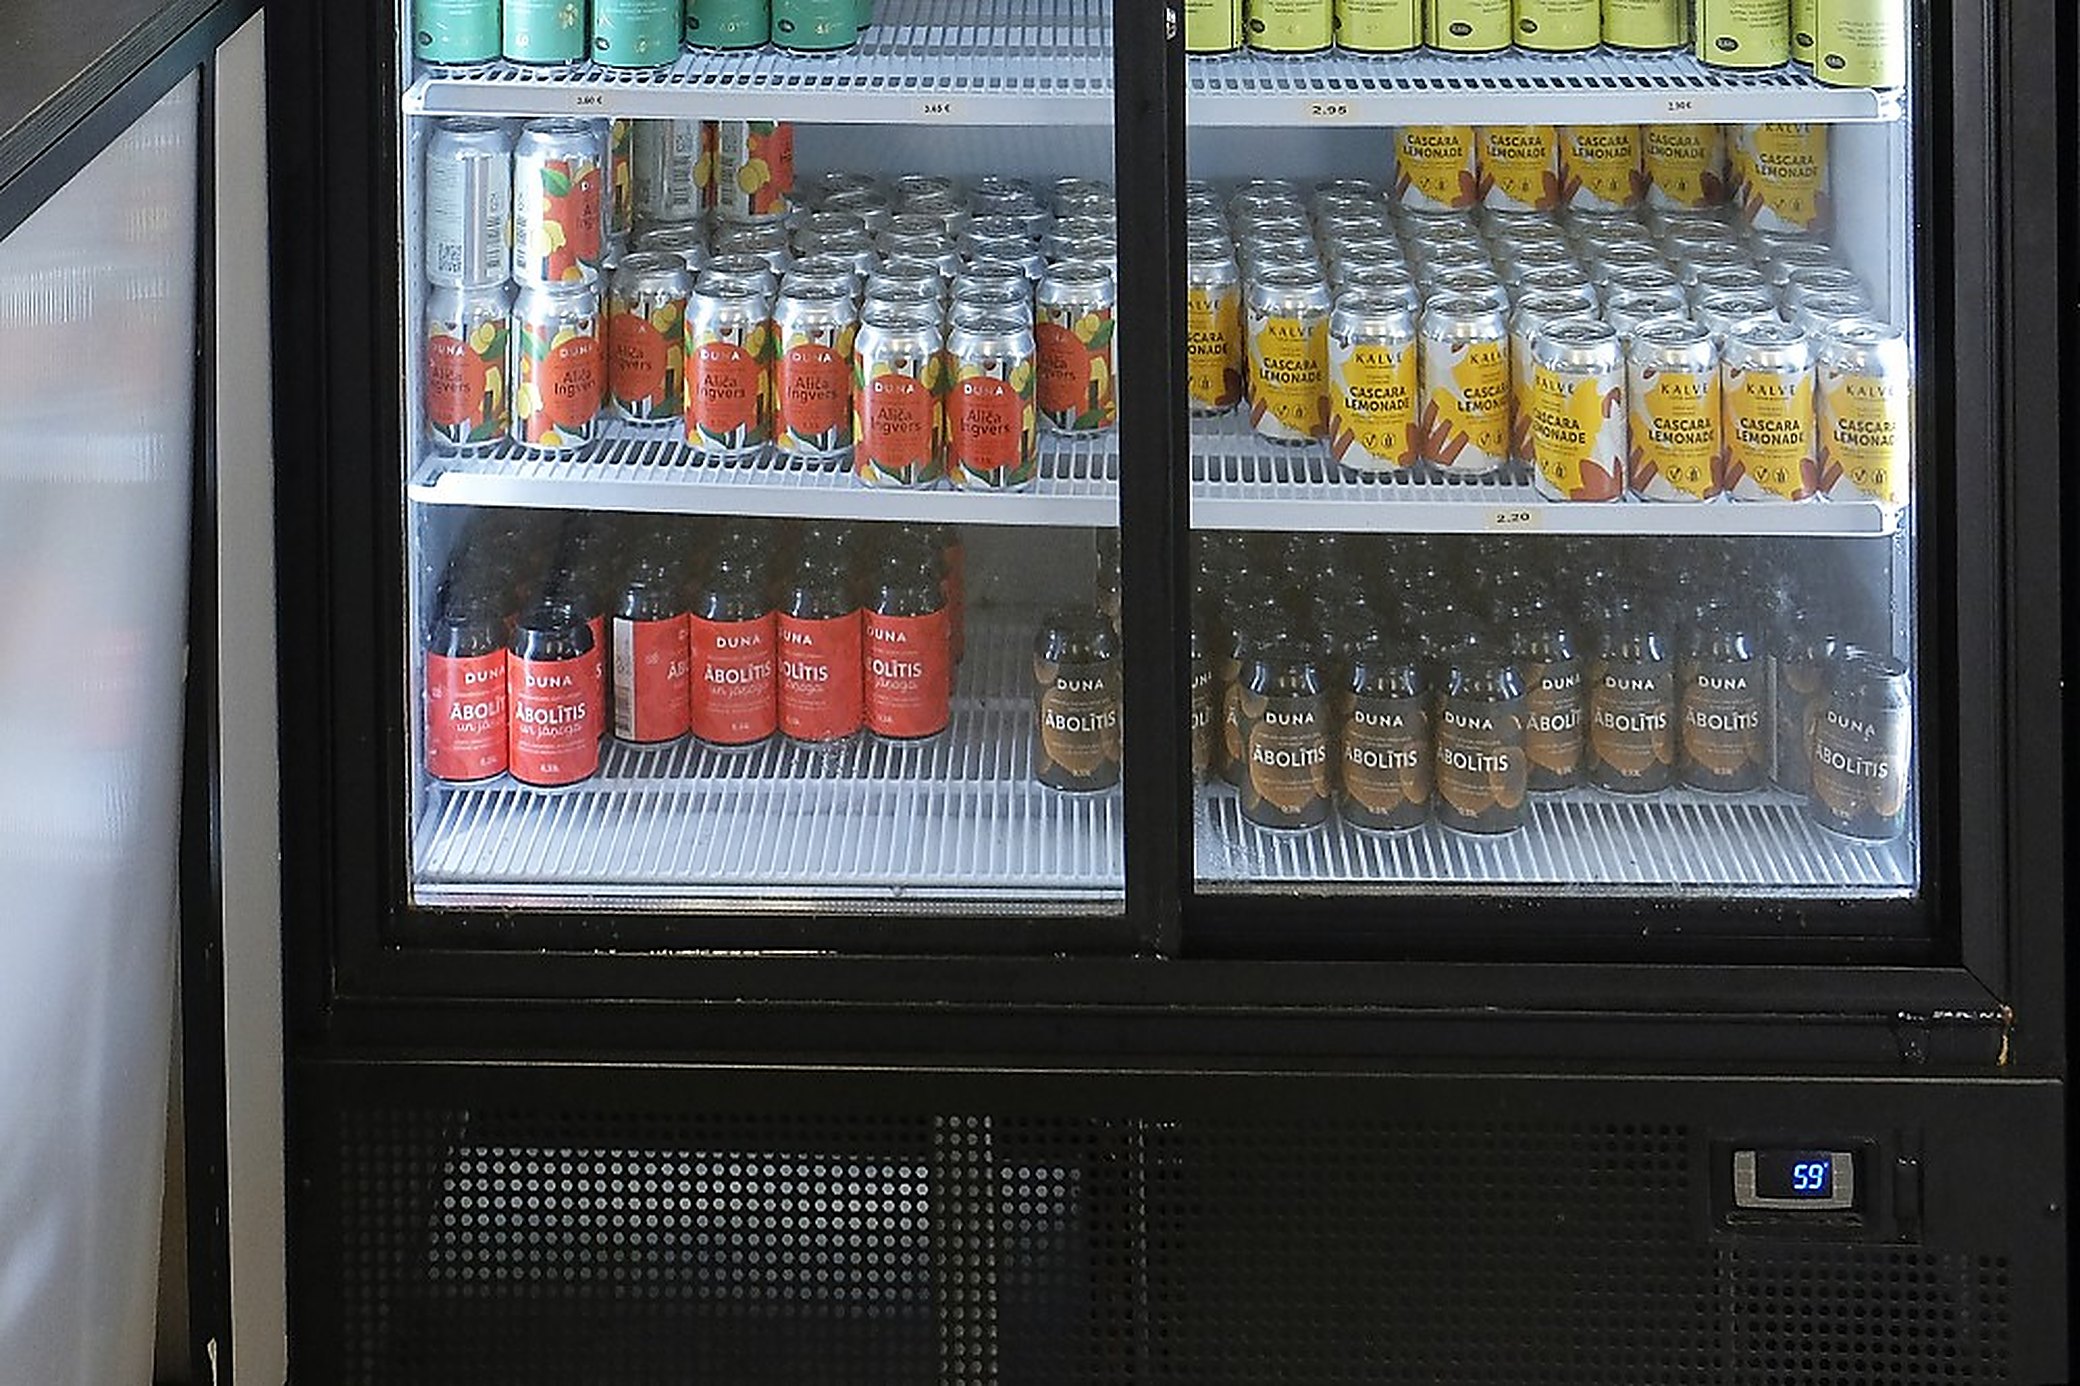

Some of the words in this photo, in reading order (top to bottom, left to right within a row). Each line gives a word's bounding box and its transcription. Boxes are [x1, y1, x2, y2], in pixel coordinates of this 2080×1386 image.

[1312, 105, 1347, 115] 2.95
[1407, 134, 1459, 147] CASCARA
[1490, 134, 1542, 147] CASCARA
[1577, 135, 1629, 147] CASCARA
[1649, 132, 1701, 147] CASCARA
[1403, 147, 1463, 159] LEMONADE
[1486, 147, 1546, 159] LEMONADE
[1572, 146, 1632, 159] LEMONADE
[1648, 146, 1706, 160] LEMONADE
[1759, 153, 1814, 166] CASCARA
[1756, 164, 1818, 178] LEMONADE
[1268, 326, 1314, 338] KALVE
[1263, 358, 1318, 371] CASCARA
[1356, 351, 1402, 365] KALVE
[1260, 370, 1322, 383] LEMONADE
[1349, 386, 1407, 399] CASCARA
[1661, 383, 1708, 396] KALVE
[1746, 384, 1796, 396] KALVE
[1345, 397, 1409, 412] LEMONADE
[1653, 417, 1711, 431] CASCARA
[1740, 417, 1800, 432] CASCARA
[1649, 430, 1714, 444] LEMONADE
[1736, 429, 1803, 444] LEMONADE
[1496, 513, 1530, 523] 2.20
[716, 635, 761, 648] DUNA
[705, 660, 771, 684] ĀBOLĪTIS
[526, 676, 573, 688] DUNA
[1057, 679, 1104, 692] DUNA
[1605, 676, 1655, 690] DUNA
[1699, 675, 1748, 690] DUNA
[515, 701, 586, 724] ĀBOLĪTIS
[1266, 712, 1315, 725] DUNA
[1355, 711, 1404, 727] DUNA
[1595, 707, 1668, 732] ĀBOLĪTIS
[1686, 705, 1759, 731] ĀBOLĪTIS
[1045, 709, 1116, 732] ĀBOLĪTIS
[1443, 711, 1493, 730] DUNA
[1828, 711, 1876, 736] DUNA
[1252, 744, 1326, 768] ĀBOLĪTIS
[1345, 741, 1418, 769] ĀBOLĪTIS
[1816, 739, 1889, 779] ĀBOLĪTIS
